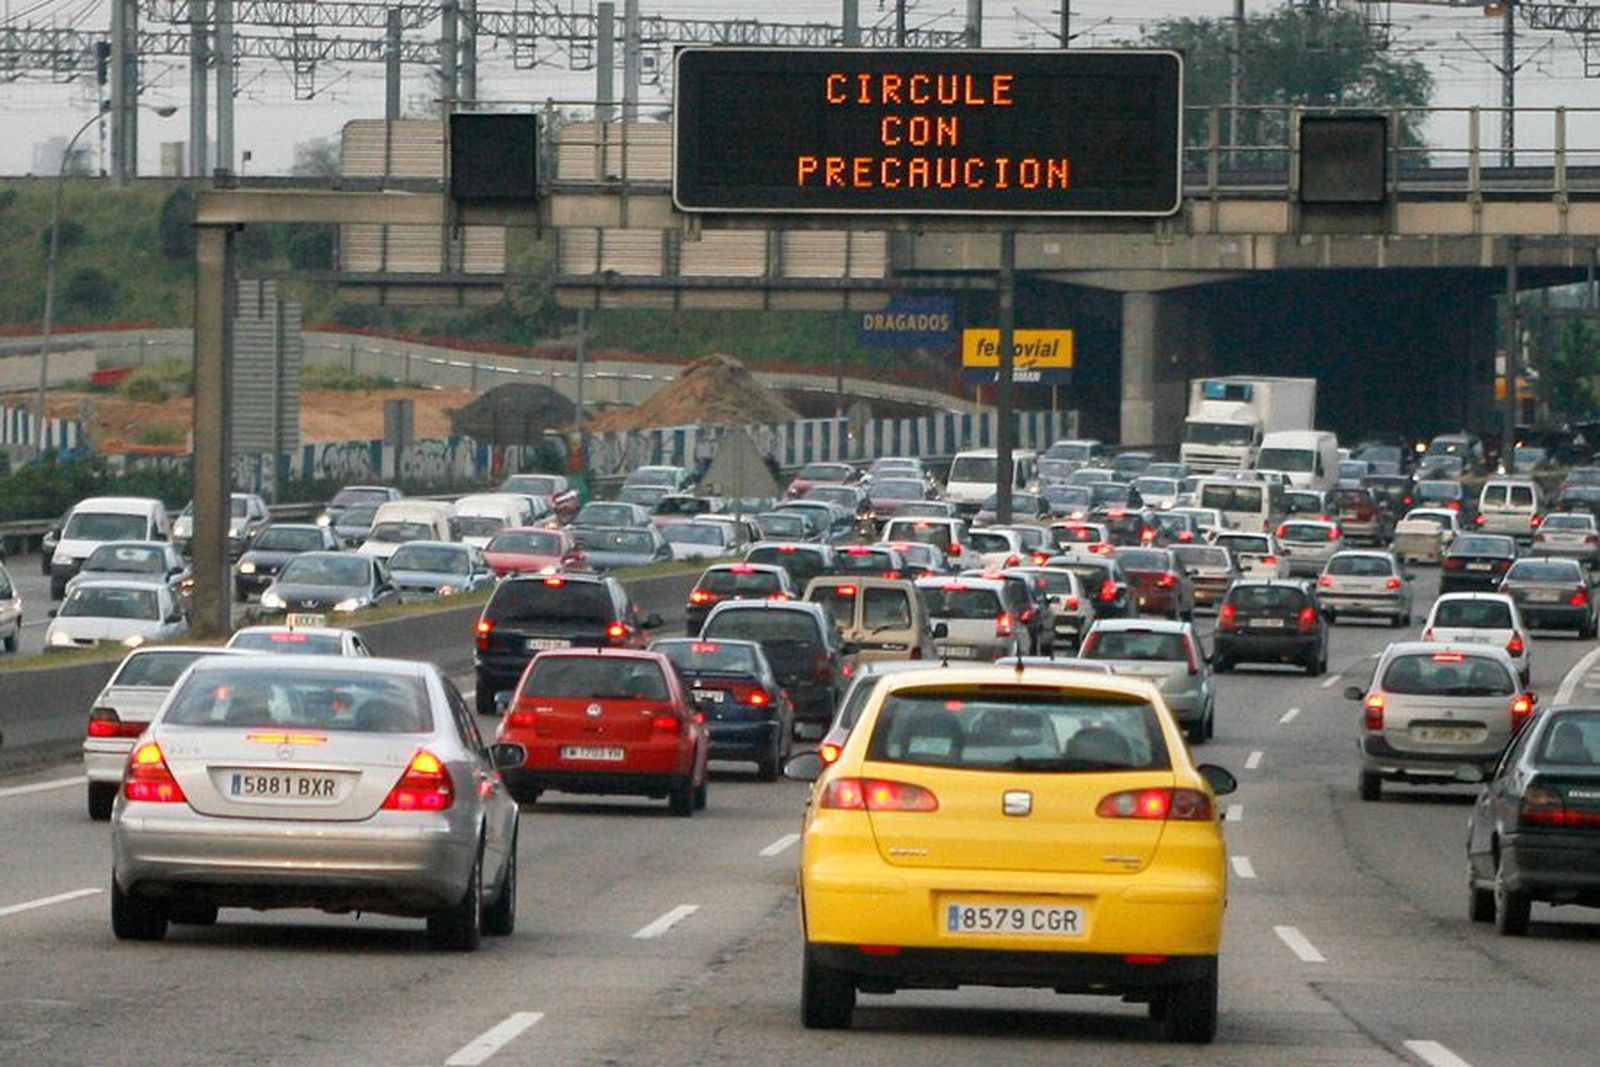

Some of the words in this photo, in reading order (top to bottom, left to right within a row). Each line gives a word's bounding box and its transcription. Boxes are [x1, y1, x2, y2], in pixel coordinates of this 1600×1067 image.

[825, 73, 1014, 106] CIRCULE
[881, 115, 961, 147] CON
[797, 156, 1070, 190] PRECAUCION
[863, 313, 950, 332] DRAGADOS
[975, 338, 1060, 357] feovial
[243, 777, 292, 794] 5881
[298, 778, 336, 797] BXR
[962, 907, 1026, 930] 8579
[1031, 909, 1079, 932] CGR
